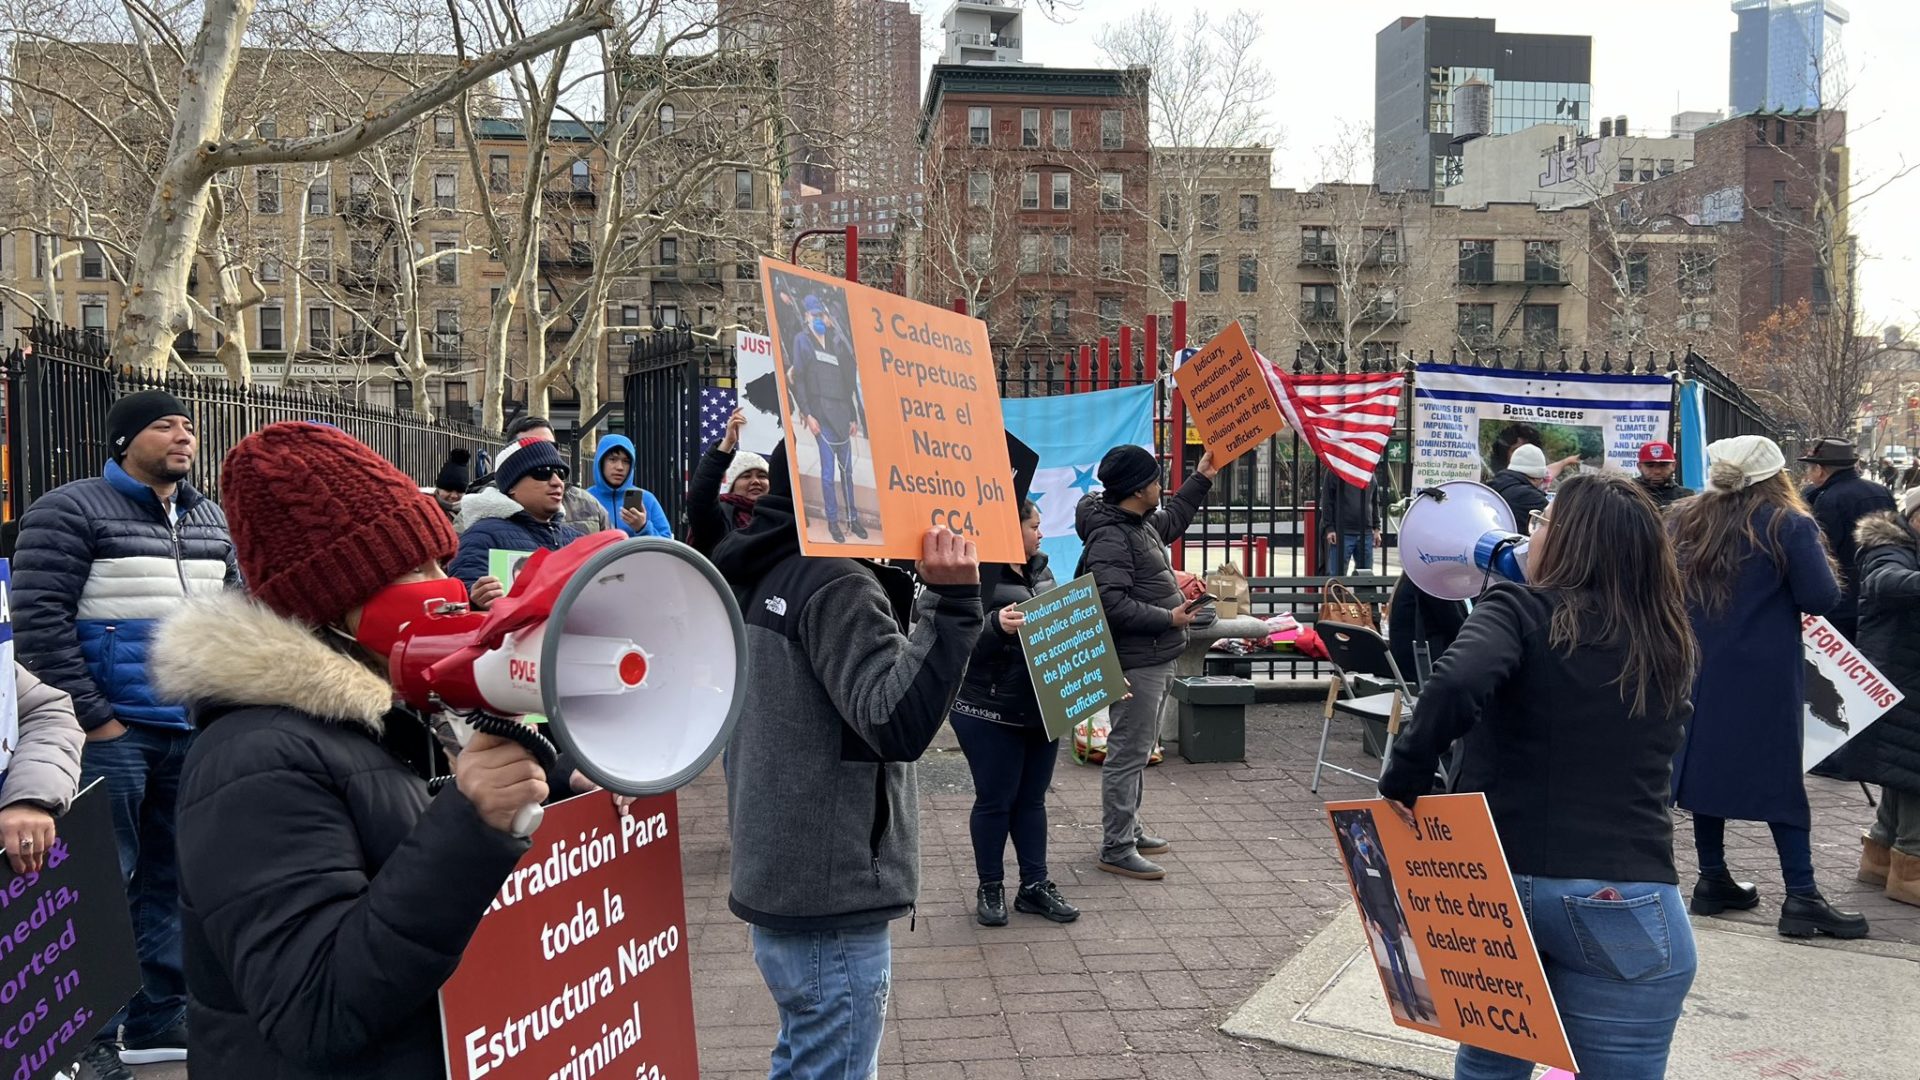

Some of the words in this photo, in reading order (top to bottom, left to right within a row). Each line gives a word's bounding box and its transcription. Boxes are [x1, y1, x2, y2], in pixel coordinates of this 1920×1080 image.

[1538, 141, 1601, 188] JET
[872, 307, 884, 333] 3
[891, 313, 973, 356] Cadenas
[212, 366, 261, 374] FUAL
[268, 366, 318, 375] SERICES,
[880, 347, 977, 392] Perpetuas
[1190, 365, 1231, 400] prosecution,
[1229, 349, 1243, 367] and
[1193, 345, 1225, 376] Judiciary,
[1196, 384, 1230, 413] Honduran
[1230, 367, 1251, 392] public
[1206, 398, 1236, 426] ministry,
[1235, 393, 1247, 407] are
[1246, 386, 1255, 398] in
[901, 396, 945, 422] para
[956, 402, 972, 426] el
[1207, 420, 1236, 445] collusion
[1235, 408, 1252, 425] with
[1252, 398, 1271, 415] drug
[1453, 414, 1463, 422] DE
[1464, 406, 1476, 414] UN
[1503, 404, 1534, 417] Berta
[1536, 406, 1584, 420] Caceres
[1629, 415, 1645, 423] LIVE
[1225, 424, 1263, 453] traffickers.
[1431, 431, 1442, 439] DE
[1444, 431, 1463, 440] NULA
[1463, 424, 1469, 432] Y
[1615, 424, 1647, 432] CLIMATE
[1619, 433, 1653, 441] IMPUNITY
[912, 429, 972, 462] Narco
[1421, 448, 1432, 456] DE
[1614, 441, 1629, 449] AND
[1442, 461, 1458, 469] Para
[889, 465, 966, 498] Asesino
[976, 475, 1005, 506] Joh
[931, 509, 980, 536] CC4.
[1023, 600, 1062, 626] Honduran
[1063, 584, 1092, 608] military
[1028, 627, 1045, 646] and
[1046, 619, 1069, 641] police
[1069, 603, 1098, 624] officers
[1033, 651, 1048, 667] are
[1049, 629, 1095, 656] accomplices
[1095, 619, 1104, 635] of
[510, 659, 536, 683] PYLE
[1043, 667, 1059, 685] the
[1058, 660, 1073, 681] Joh
[1072, 650, 1090, 669] CC4
[1090, 640, 1106, 659] and
[1809, 625, 1844, 658] FOR
[1837, 651, 1896, 708] VICTIMS
[1060, 679, 1082, 699] other
[1082, 667, 1103, 686] drug
[955, 702, 980, 716] Calvin
[980, 708, 1001, 720] Klein
[1065, 687, 1108, 719] traffickers.
[1078, 724, 1108, 738] diect
[620, 811, 668, 854] Para
[1423, 816, 1453, 841] life
[47, 837, 70, 869] &
[1405, 857, 1488, 881] sentences
[539, 900, 600, 960] toda
[603, 887, 625, 928] la
[1407, 888, 1430, 912] for
[1434, 891, 1464, 916] the
[1467, 893, 1513, 929] drug
[1426, 925, 1477, 954] dealer
[1481, 935, 1518, 960] and
[464, 965, 614, 1080] Estructura
[617, 925, 679, 986] Narco
[1440, 967, 1532, 1006] murderer,
[0, 997, 49, 1049] cos
[54, 968, 80, 1002] in
[1454, 998, 1486, 1028] Joh
[1487, 1005, 1537, 1039] CC4.
[13, 1006, 93, 1080] duras.
